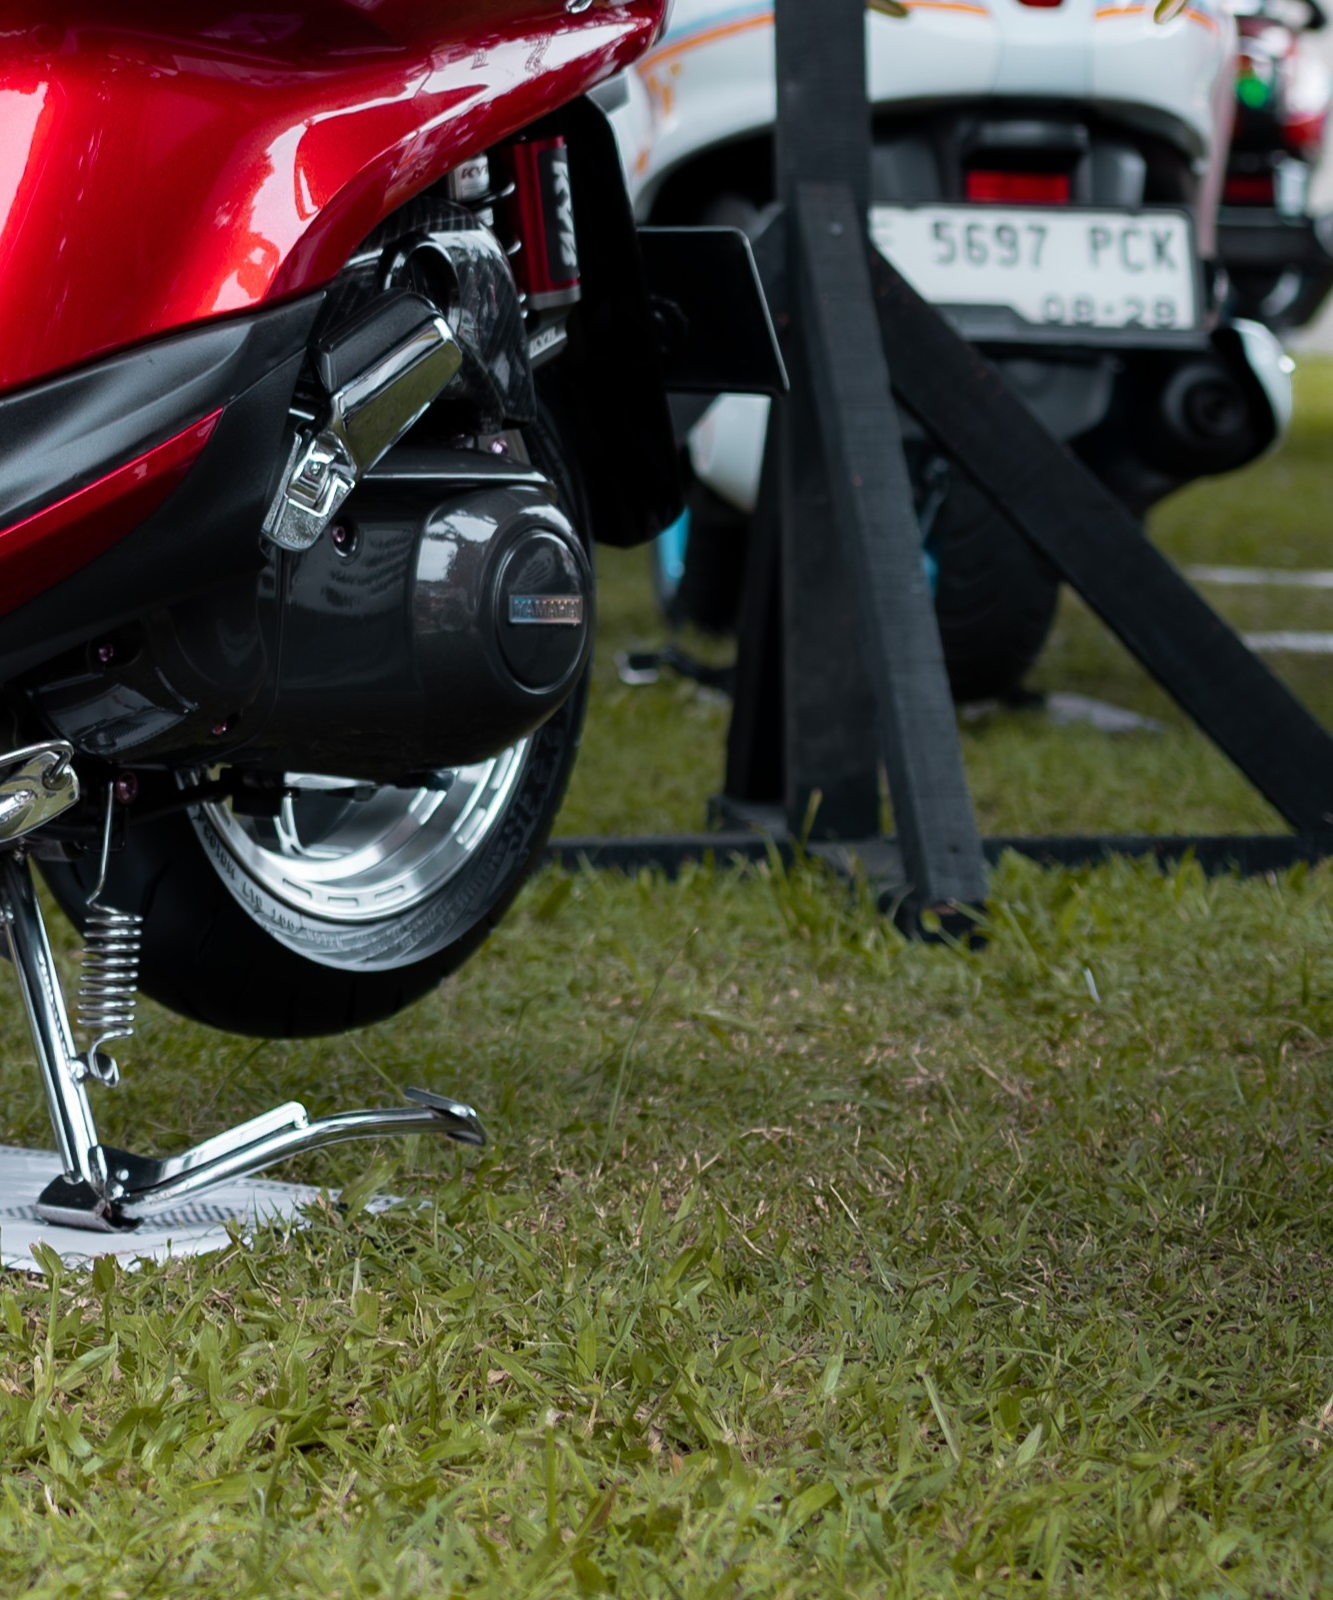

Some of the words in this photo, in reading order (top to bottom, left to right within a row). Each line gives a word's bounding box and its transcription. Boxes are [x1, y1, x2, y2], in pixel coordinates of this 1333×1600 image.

[930, 220, 1049, 268] 5697
[1088, 224, 1178, 274] PCK
[513, 597, 582, 620] YAMAHA
